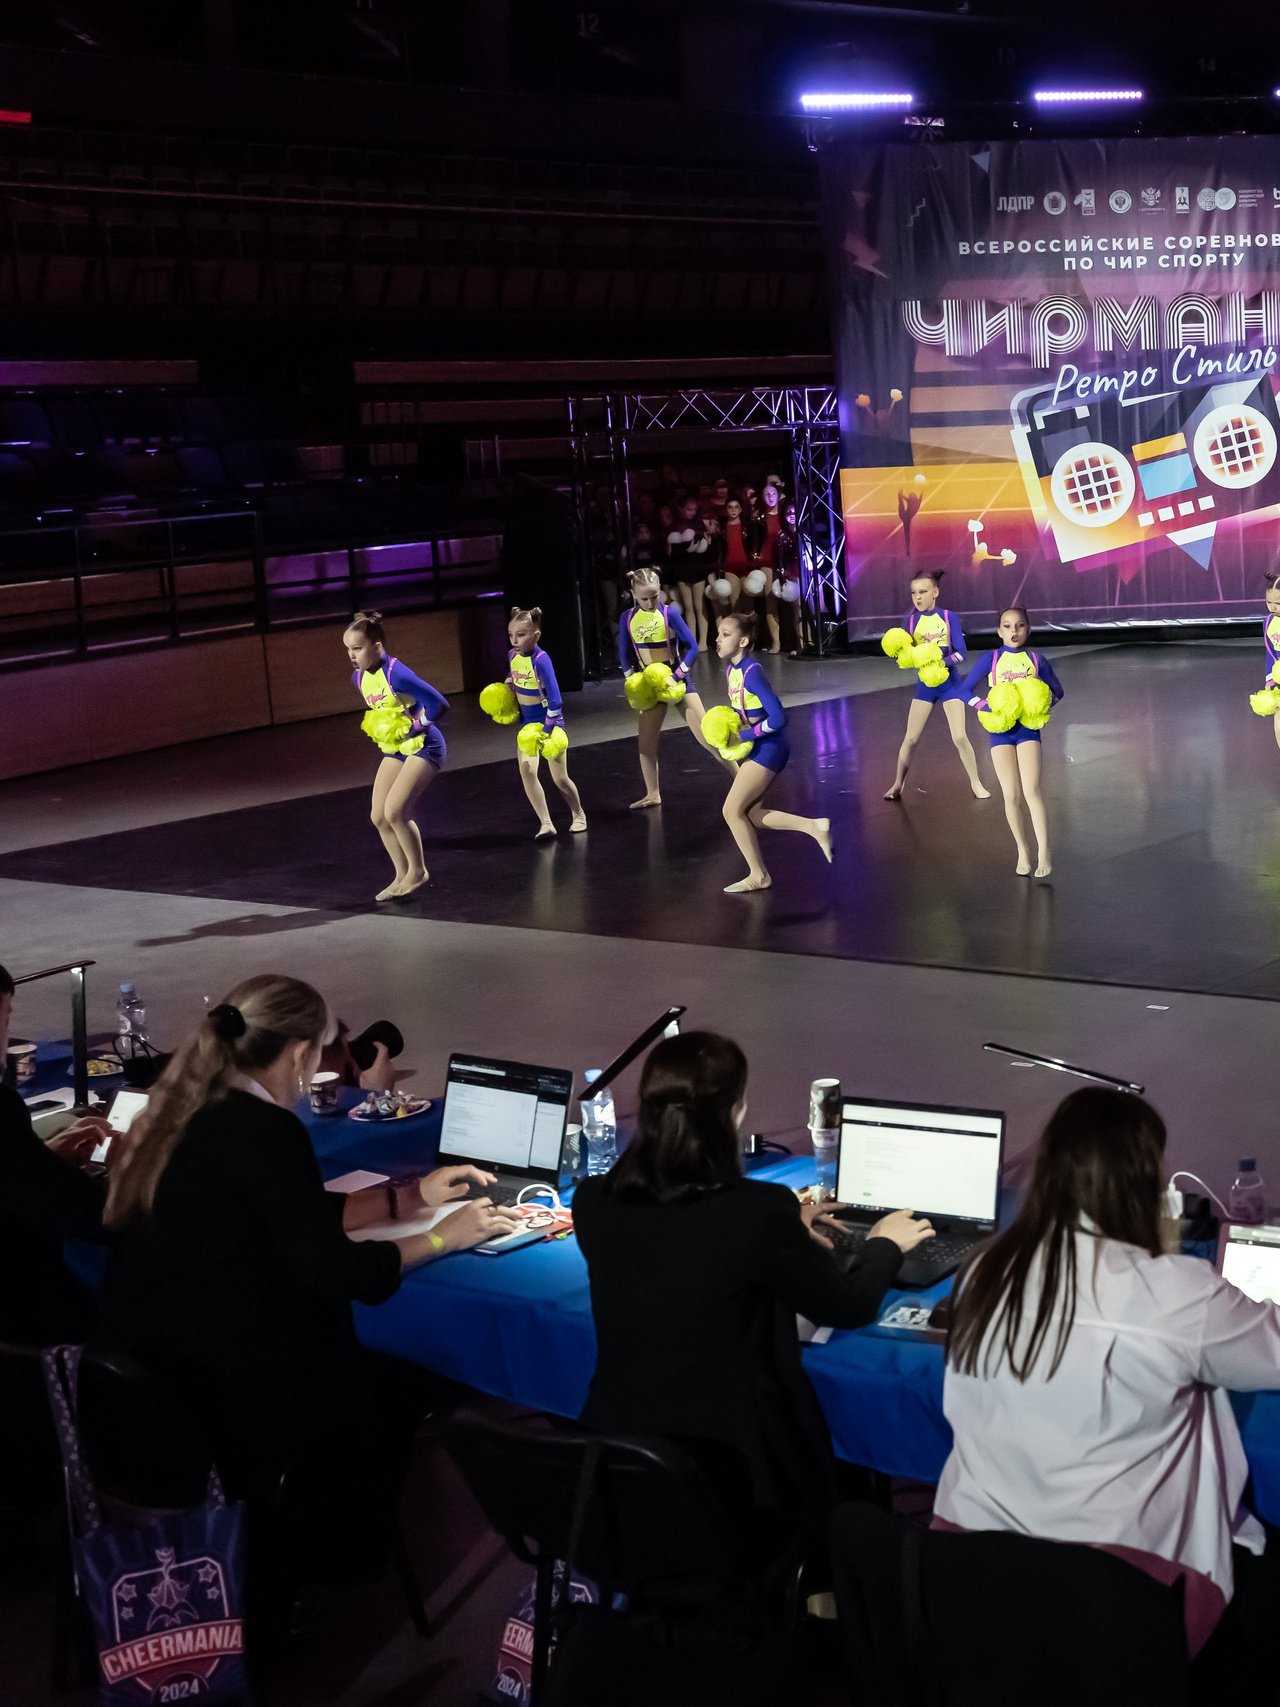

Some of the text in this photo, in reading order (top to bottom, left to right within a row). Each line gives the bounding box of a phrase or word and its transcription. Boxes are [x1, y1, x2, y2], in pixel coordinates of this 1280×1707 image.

[577, 12, 600, 34] 12
[996, 196, 1035, 213] ЛДПР
[959, 235, 1154, 256] ВСЕРОССИЙСКИЕ
[1064, 252, 1246, 271] ПО ЧИР СПОРТУ
[1052, 345, 1278, 406] Ретро Стиль
[104, 1625, 243, 1679] CHEERMANIA
[160, 1678, 200, 1703] 2024
[497, 1673, 522, 1700] 2024
